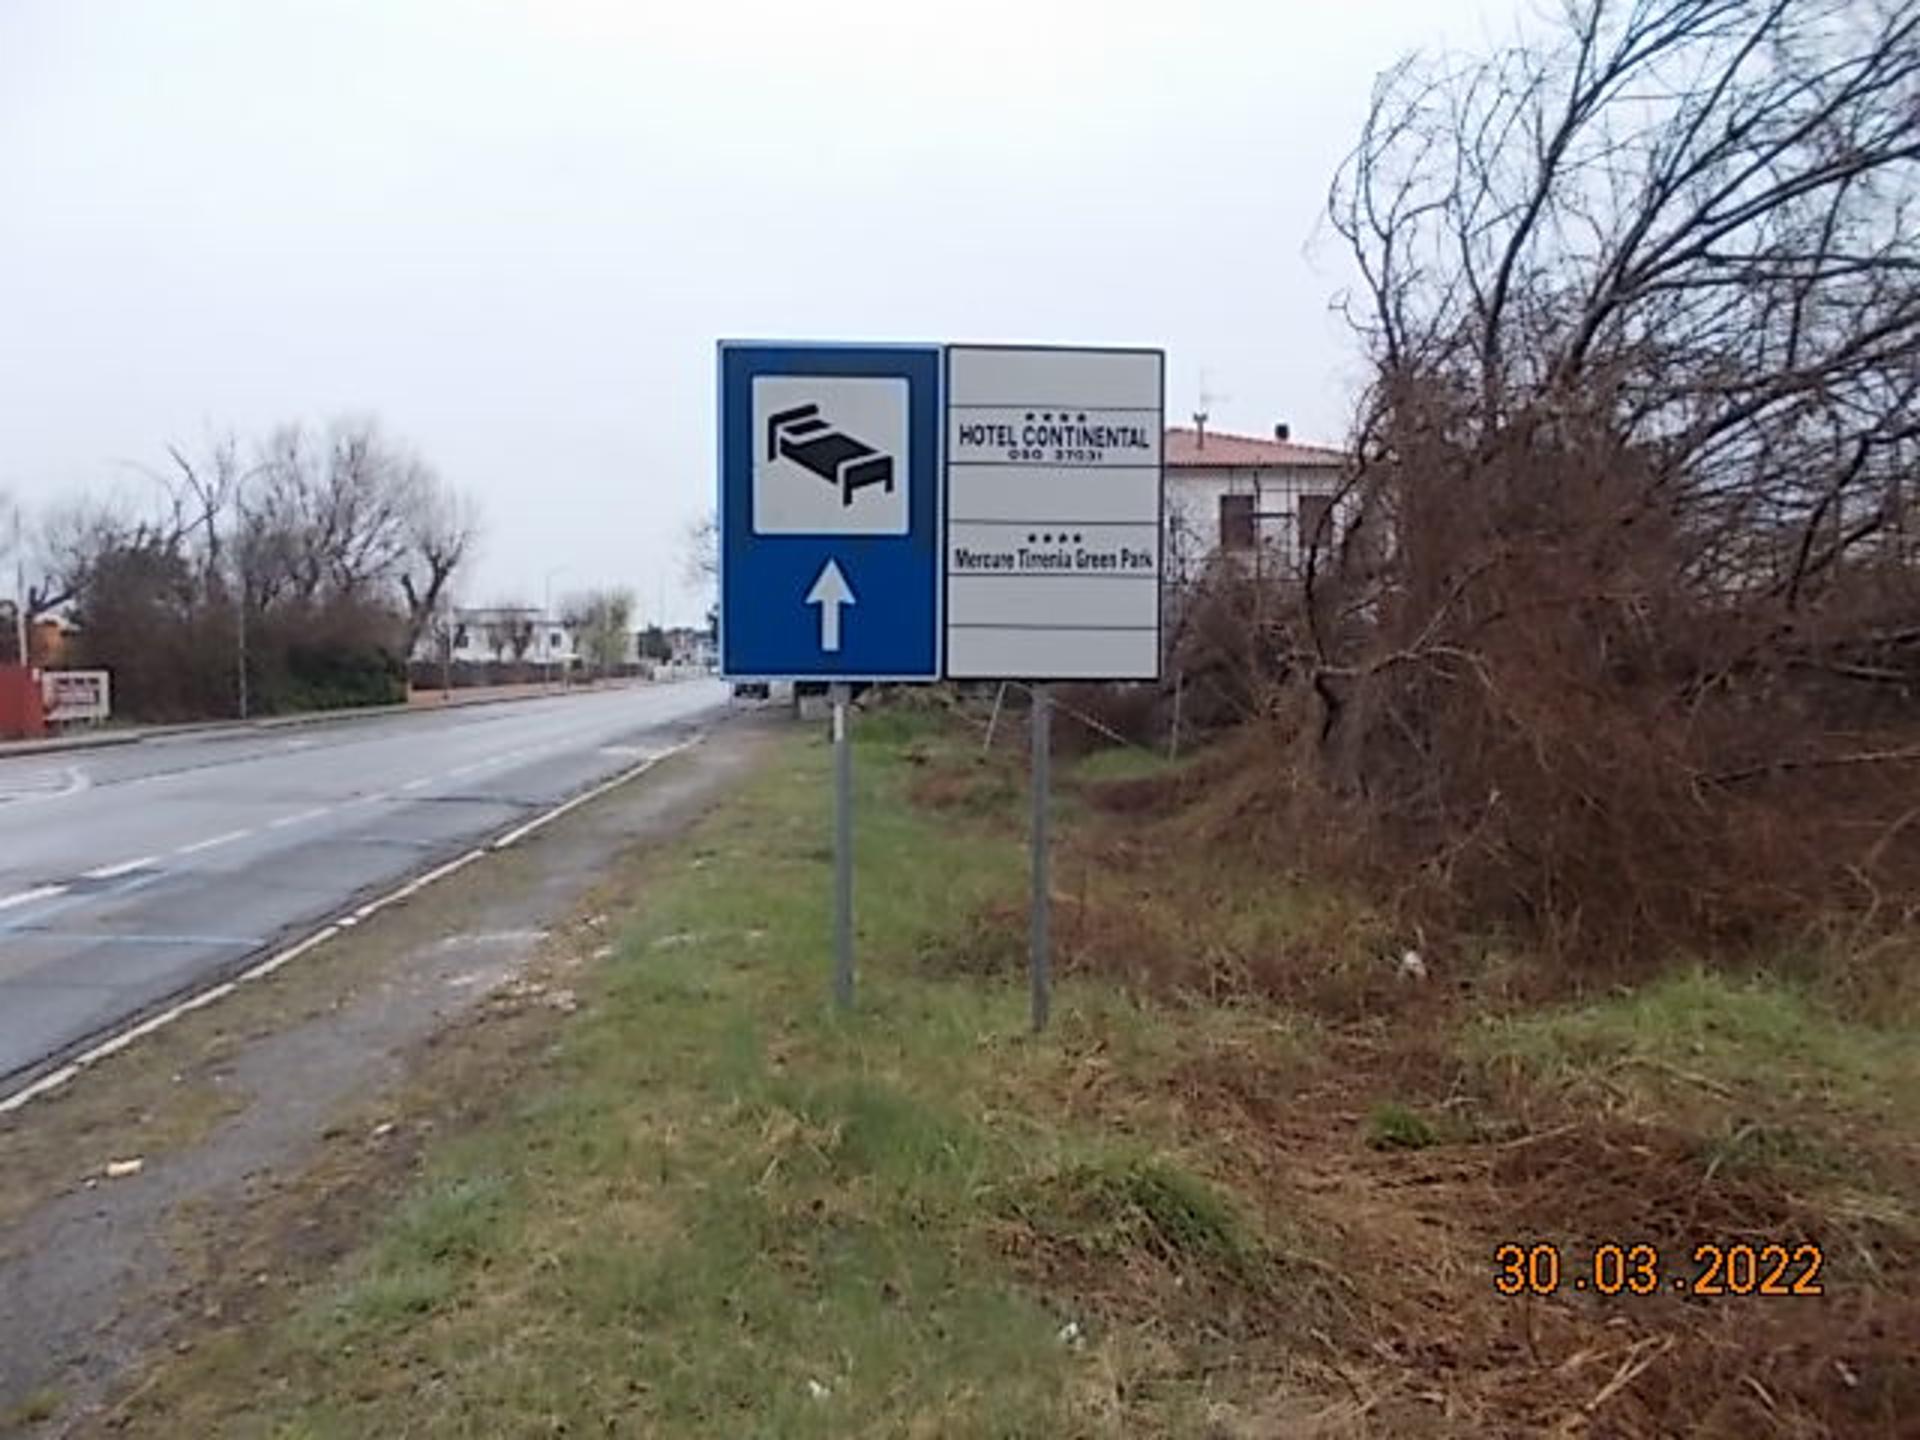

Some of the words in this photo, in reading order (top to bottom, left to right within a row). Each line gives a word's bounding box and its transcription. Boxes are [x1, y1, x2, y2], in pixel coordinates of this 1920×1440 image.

[959, 425, 1017, 446] HOTEL
[1022, 425, 1150, 448] CONTINENTAL
[1076, 549, 1116, 569] Green
[1121, 548, 1153, 570] Park
